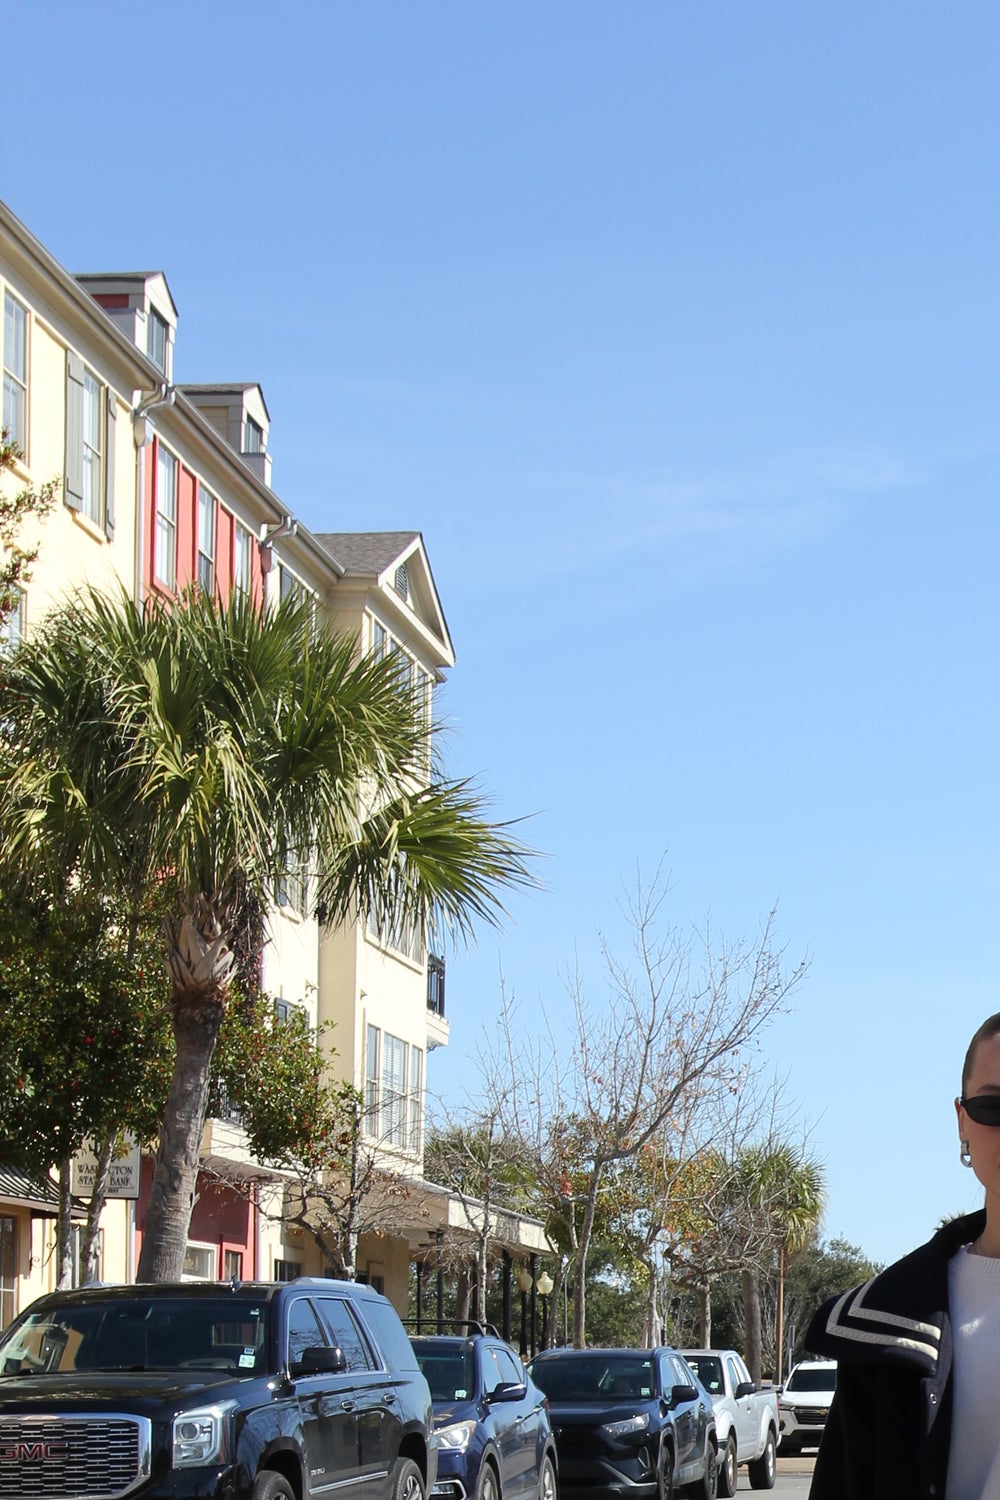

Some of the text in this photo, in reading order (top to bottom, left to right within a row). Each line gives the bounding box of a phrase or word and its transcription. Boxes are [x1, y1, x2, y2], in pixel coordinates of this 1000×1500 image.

[77, 1164, 133, 1176] WASGTON
[77, 1175, 131, 1187] STA BANK
[0, 1442, 68, 1460] GMC
